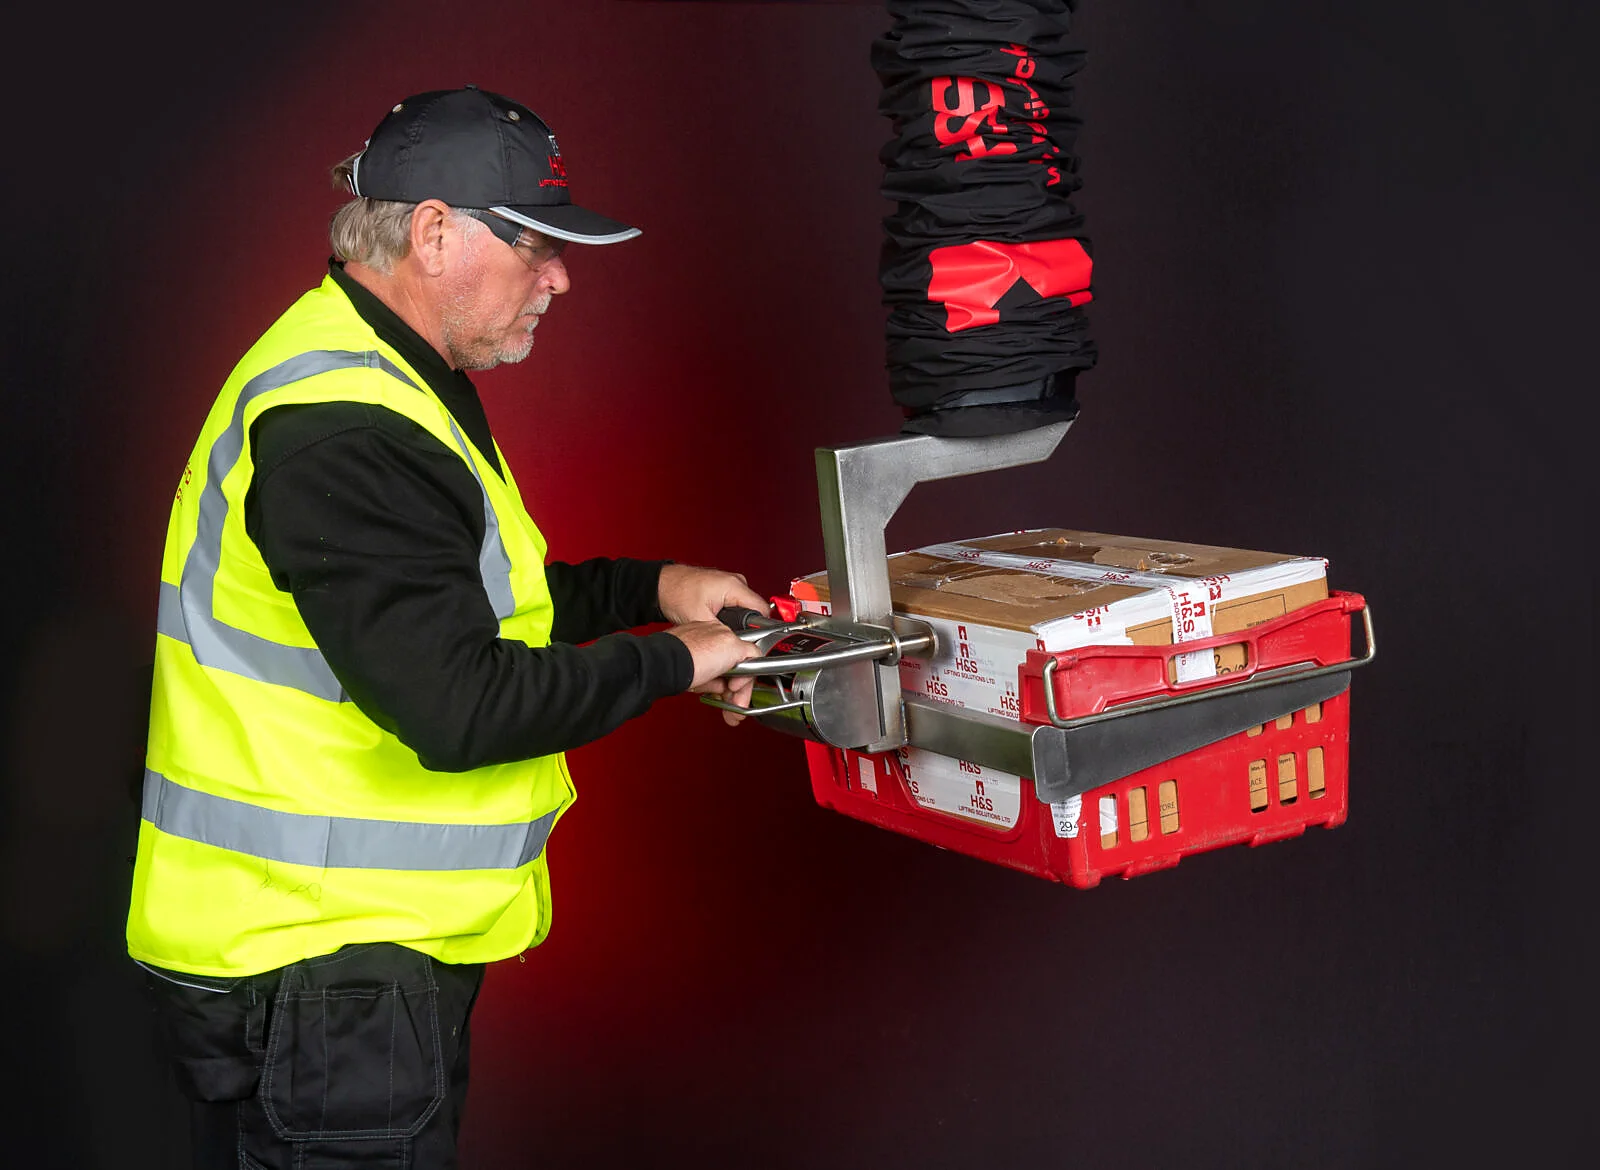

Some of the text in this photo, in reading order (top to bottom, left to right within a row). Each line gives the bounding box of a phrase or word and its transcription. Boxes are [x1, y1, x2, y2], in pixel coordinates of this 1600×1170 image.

[1178, 592, 1195, 633] H&S
[1173, 602, 1184, 642] SOLUTION
[955, 657, 978, 674] H&S
[943, 669, 996, 685] LIFTING SOLUTIONS LTD
[925, 680, 948, 697] H&S
[987, 707, 1020, 719] LIFTING SOLUT
[959, 760, 982, 775] H&S
[970, 794, 993, 812] H&S
[958, 805, 1011, 824] LIFTING SOLUTIONS LTD
